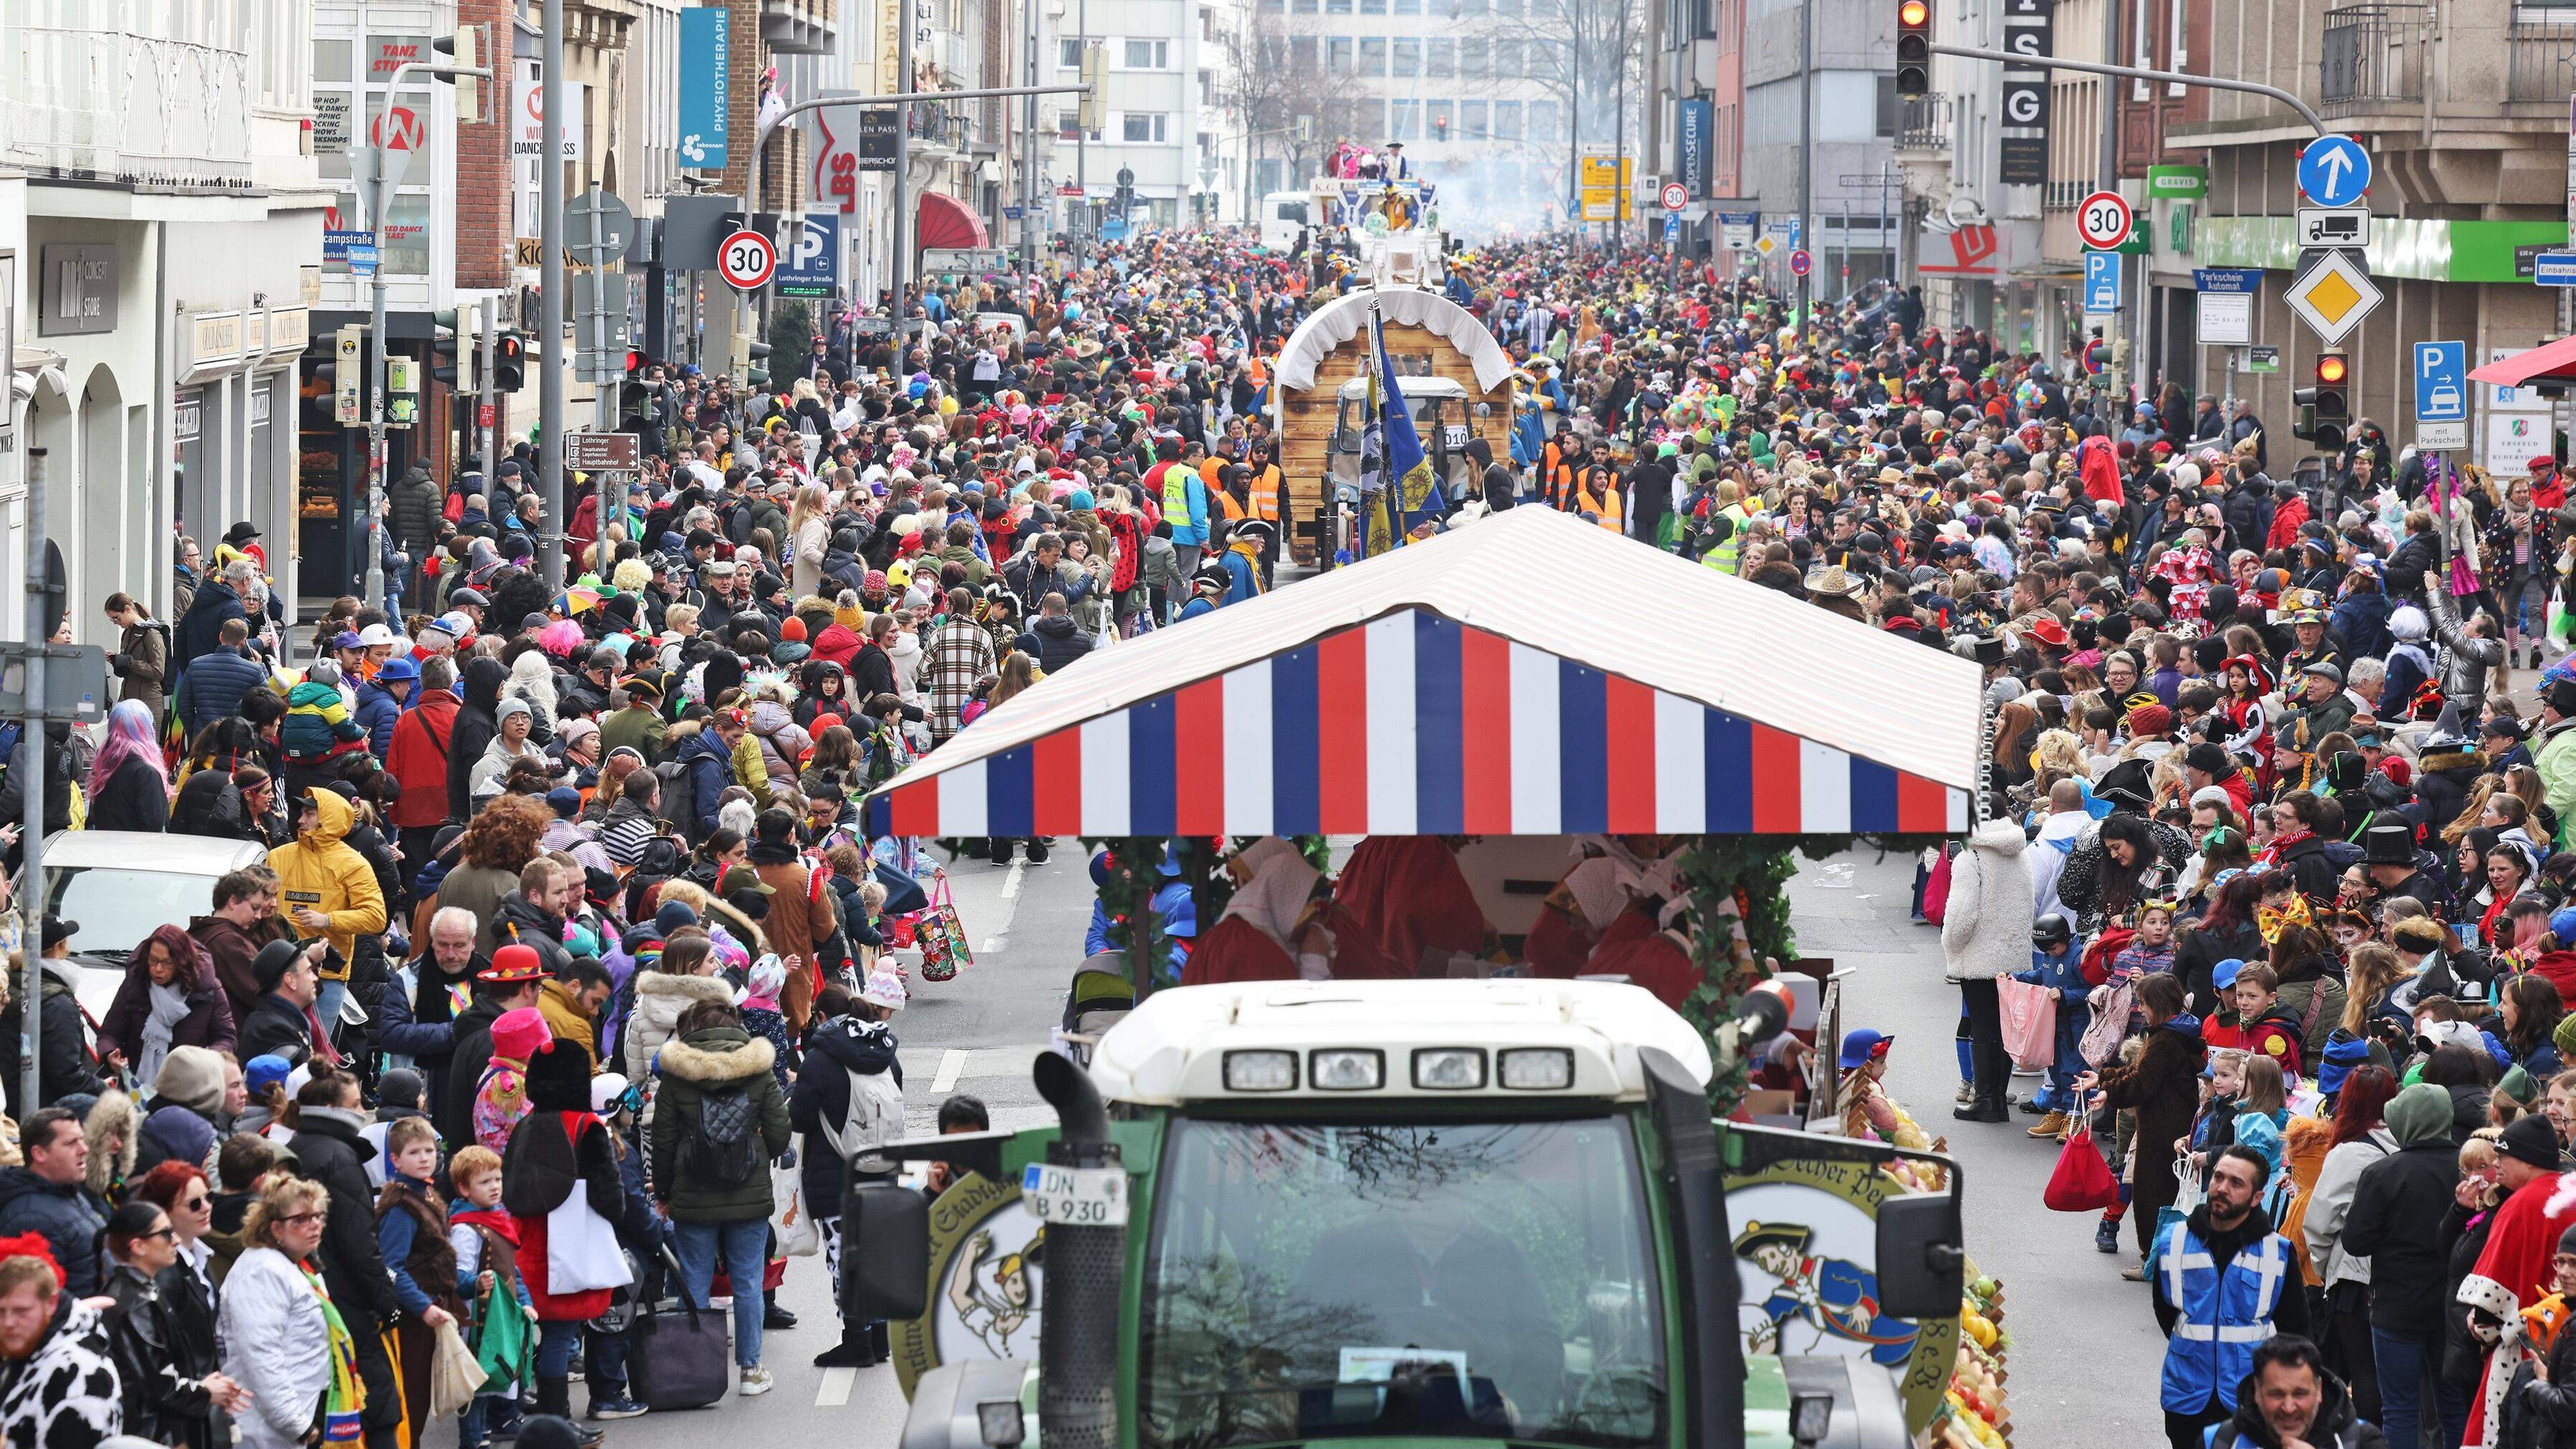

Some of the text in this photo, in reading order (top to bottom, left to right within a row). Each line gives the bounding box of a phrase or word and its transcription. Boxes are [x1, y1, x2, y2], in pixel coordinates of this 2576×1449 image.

[382, 45, 418, 58] TANZ
[373, 60, 424, 72] STU
[714, 10, 726, 131] PHYSIOTHERAPIE
[515, 142, 543, 155] DANCE
[1686, 107, 1697, 180] OPENSECURE
[831, 152, 856, 213] LBS
[1668, 191, 1682, 203] 30
[1666, 215, 1673, 225] P
[2088, 208, 2119, 233] 30
[1792, 222, 1800, 234] P
[324, 233, 372, 247] campstraße
[350, 250, 377, 262] Theaterstraße
[793, 231, 823, 270] P
[2546, 247, 2571, 255] Zentru
[731, 246, 763, 273] 30
[2090, 256, 2106, 280] P
[2541, 266, 2576, 274] Einbahns
[778, 274, 812, 283] Lothringer
[2200, 271, 2243, 282] Parkschein
[2208, 281, 2241, 290] Automat
[84, 297, 100, 317] STORE
[2423, 347, 2444, 378] P
[2420, 435, 2463, 444] Parkschein
[582, 459, 619, 467] Hauptbahnhof
[1046, 1172, 1075, 1194] DN
[1061, 1200, 1107, 1222] 930
